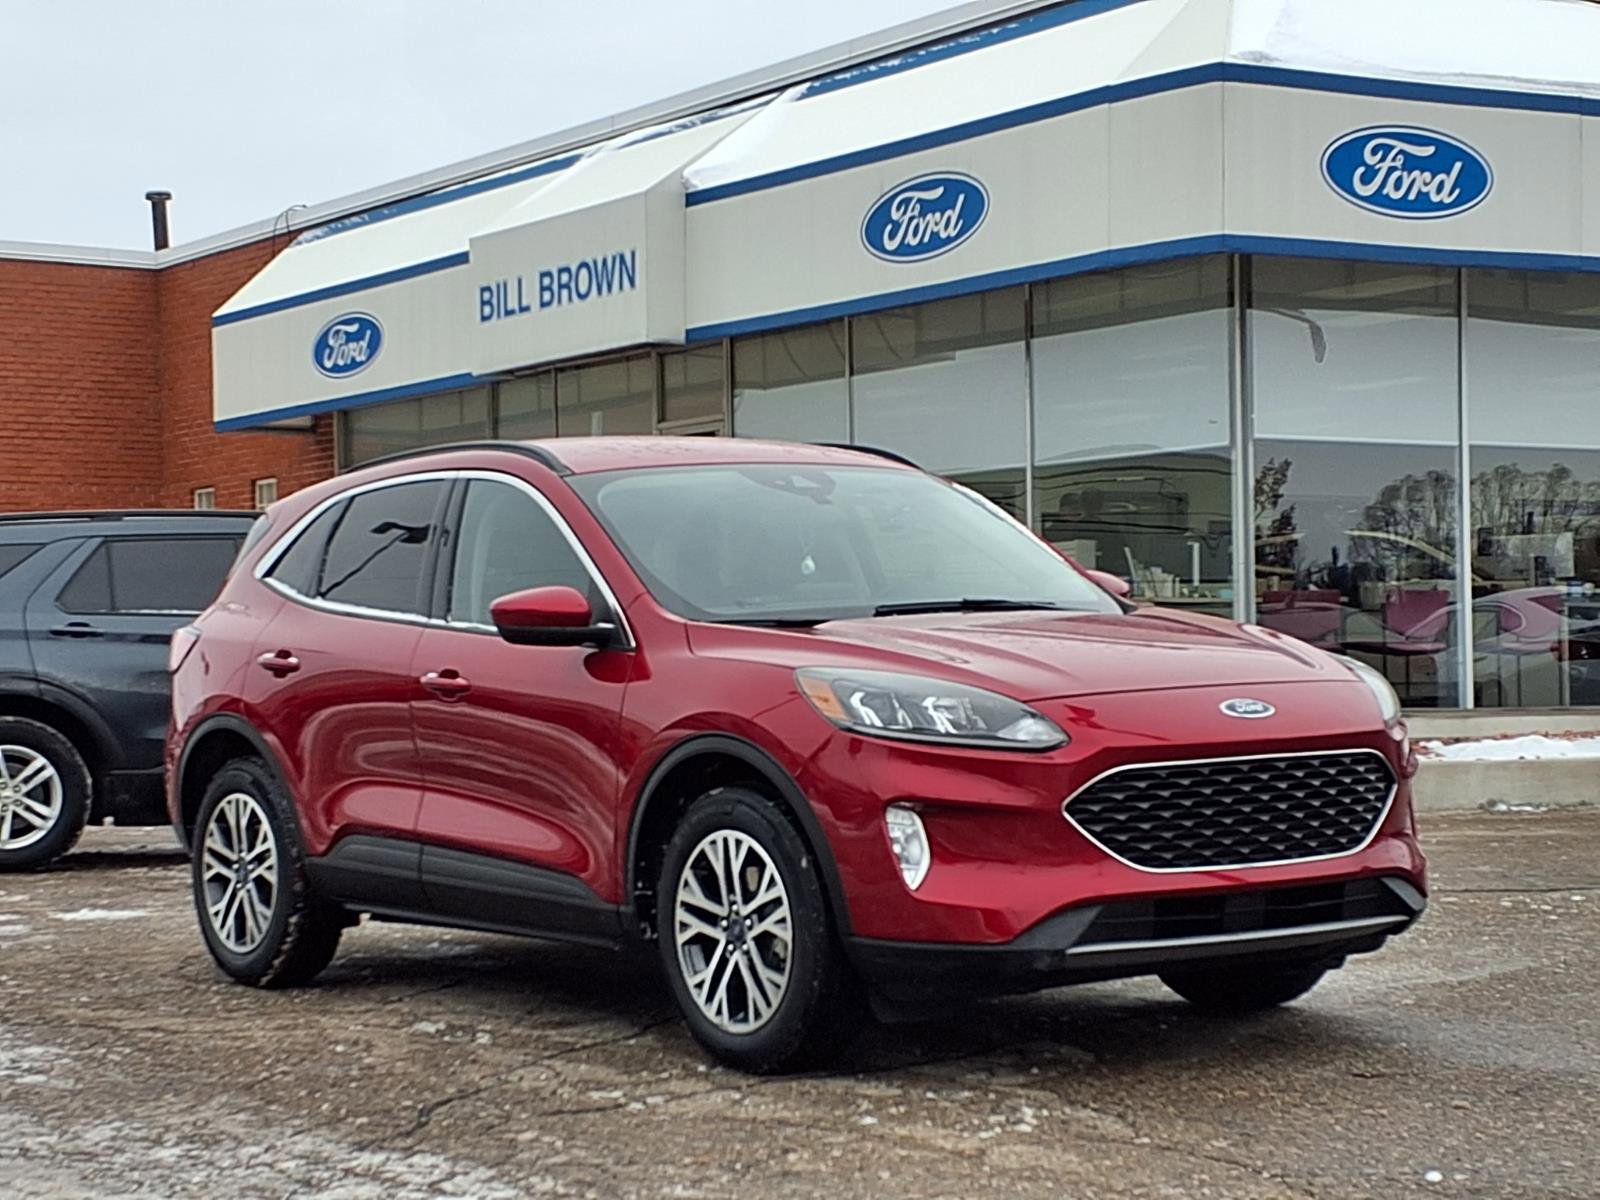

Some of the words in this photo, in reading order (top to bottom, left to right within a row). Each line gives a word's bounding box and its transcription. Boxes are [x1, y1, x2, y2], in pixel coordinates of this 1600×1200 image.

[1352, 137, 1463, 204] Ford
[883, 185, 965, 251] Ford
[479, 277, 531, 323] BILL
[538, 249, 637, 309] BROWN
[323, 322, 371, 368] Ford
